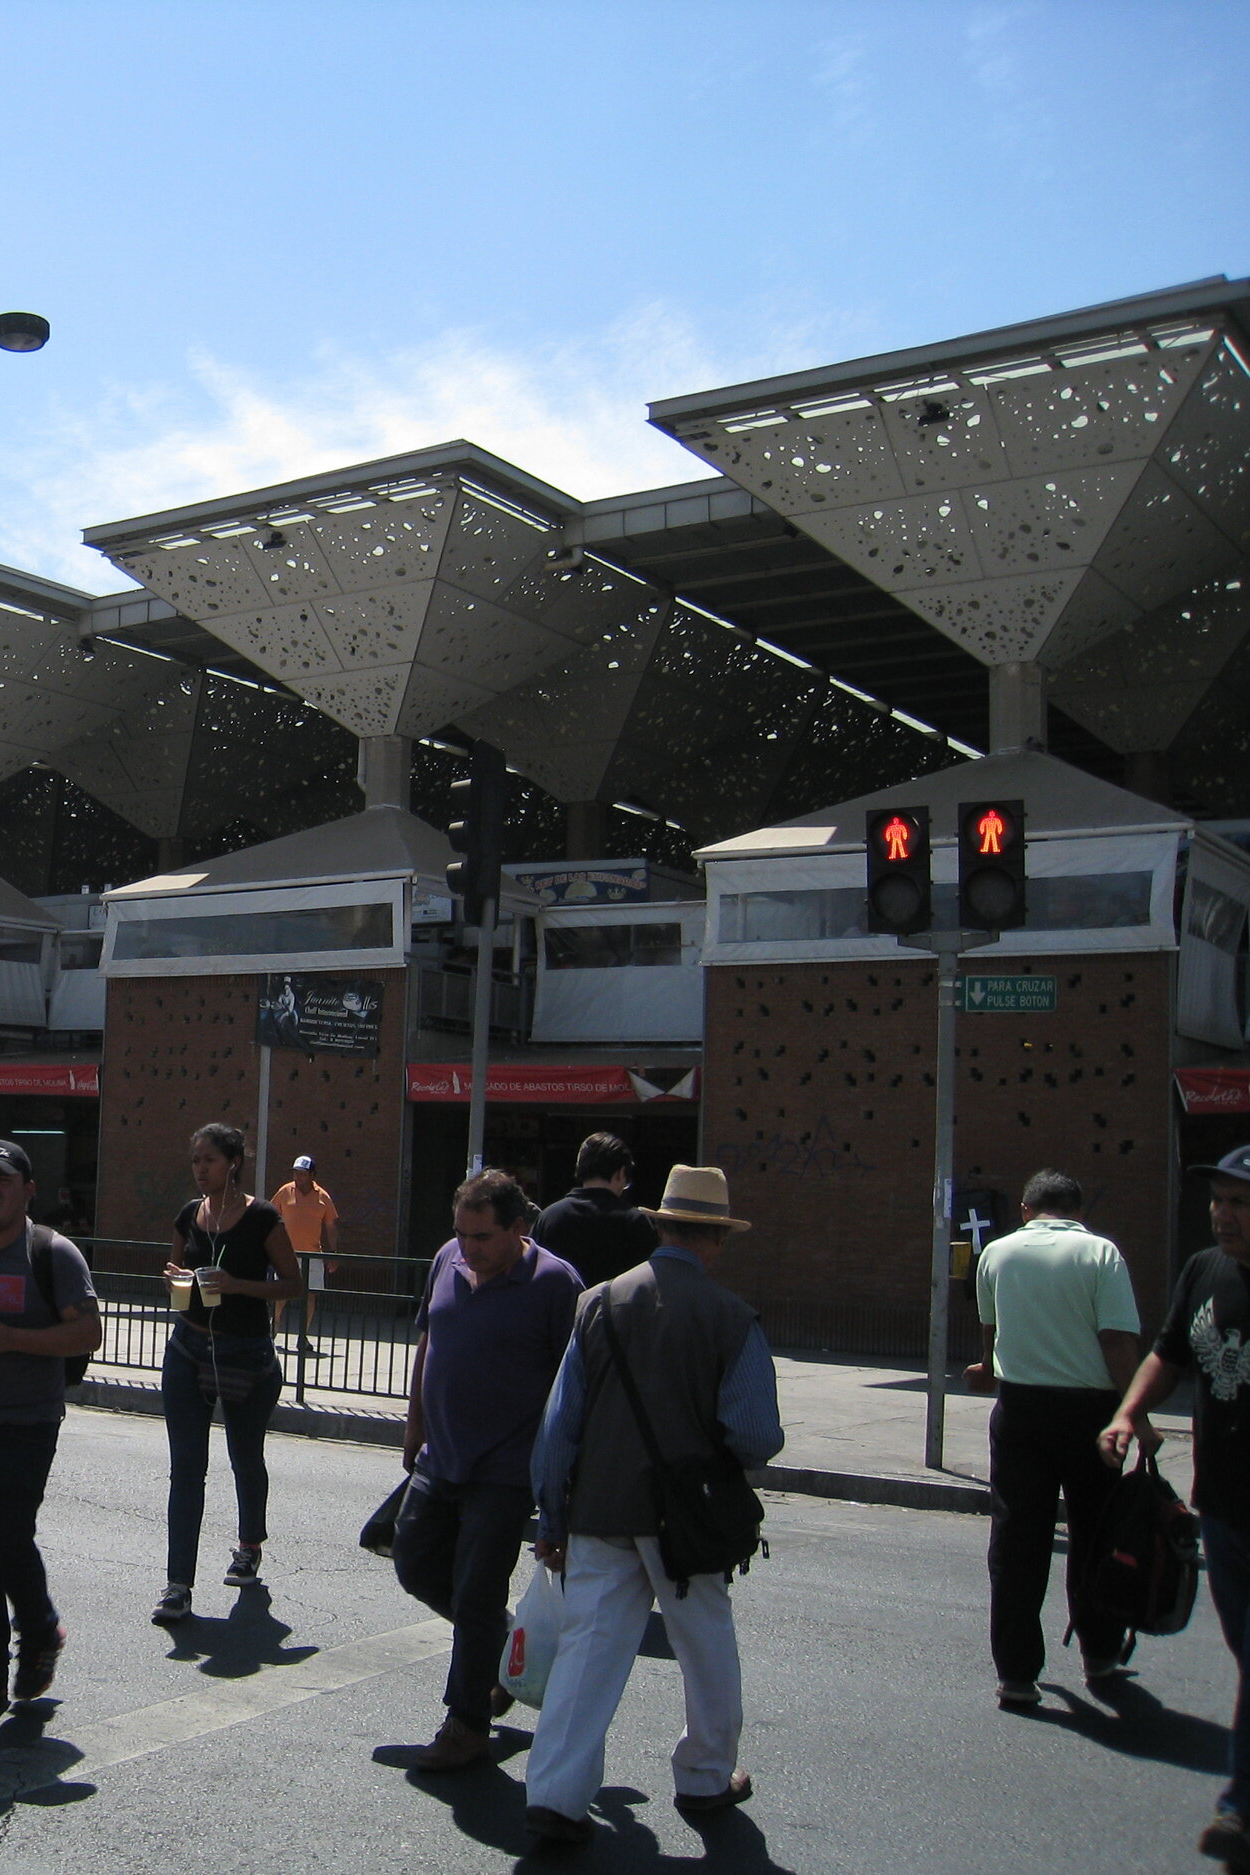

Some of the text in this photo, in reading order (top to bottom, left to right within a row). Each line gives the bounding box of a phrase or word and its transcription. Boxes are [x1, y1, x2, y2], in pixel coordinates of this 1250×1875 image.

[554, 873, 568, 885] DE
[568, 872, 586, 882] LAS
[987, 980, 1054, 992] PARA CRUZAR
[987, 995, 1050, 1007] PULSE BOTON
[15, 1079, 32, 1087] TIRSO
[33, 1079, 41, 1087] DE
[42, 1079, 67, 1087] MOLINA
[463, 1081, 508, 1092] MCADO
[509, 1082, 522, 1091] DE
[523, 1082, 565, 1092] ABASTOS
[566, 1082, 594, 1092] TIRSO
[595, 1083, 608, 1093] DE
